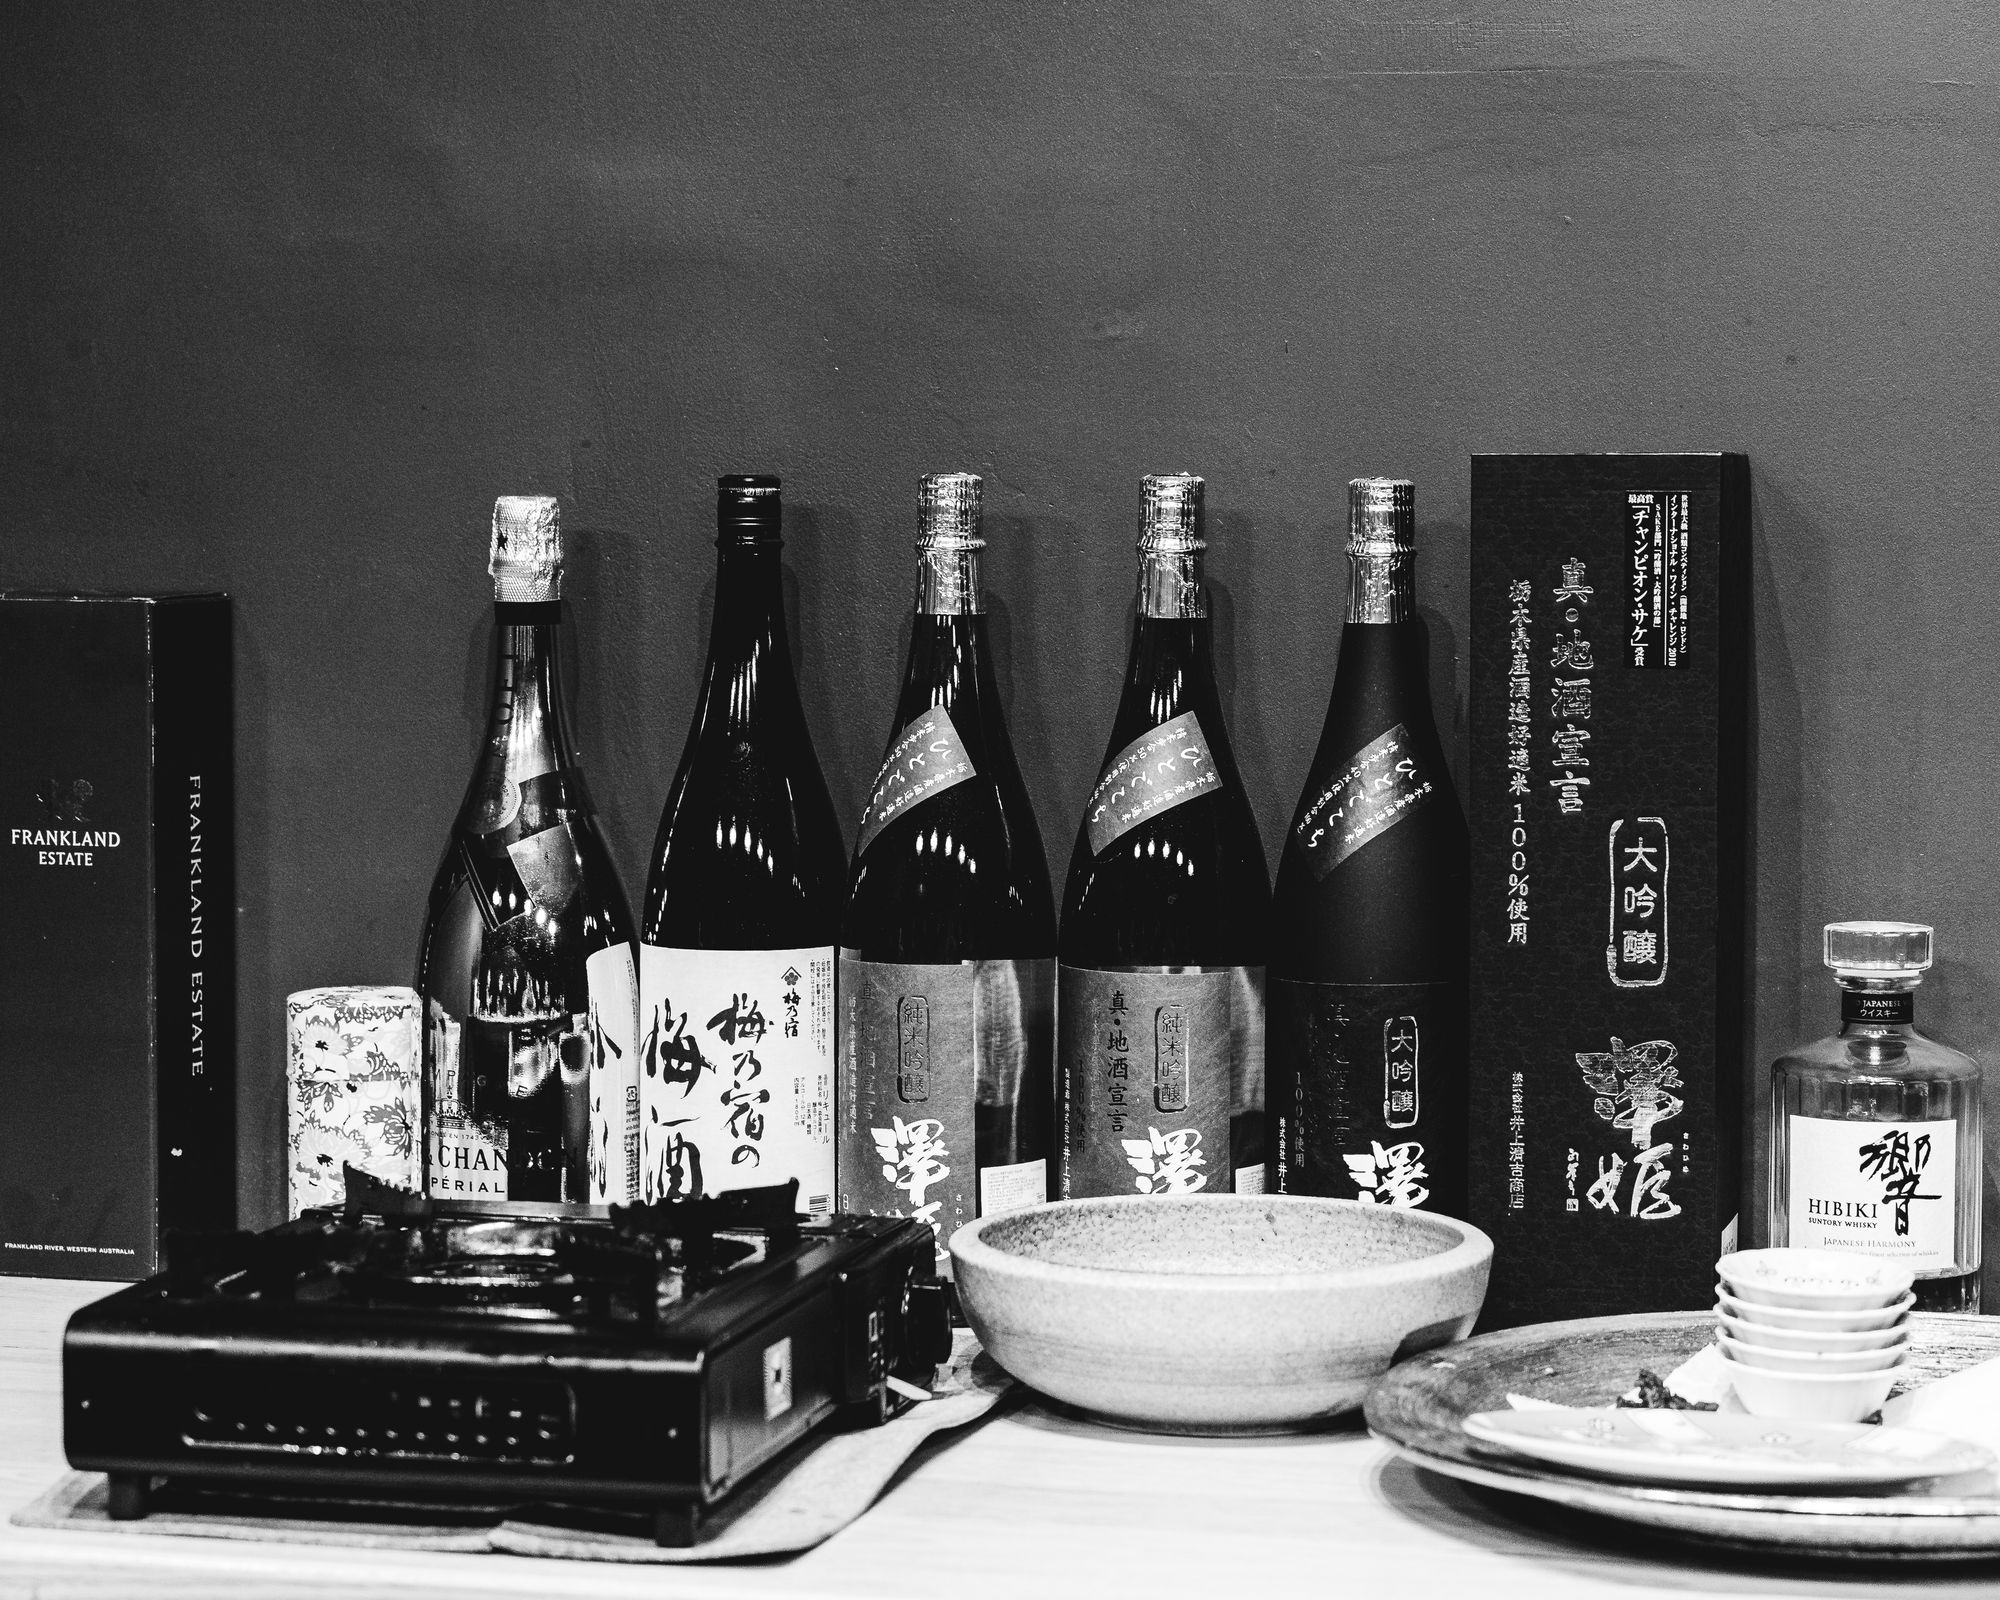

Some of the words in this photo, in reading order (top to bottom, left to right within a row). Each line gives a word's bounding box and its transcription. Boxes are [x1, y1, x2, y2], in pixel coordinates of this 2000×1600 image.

[1627, 493, 1655, 504] 最高賞
[1631, 504, 1651, 667] 「チャンピオン・サケ」受賞
[1668, 494, 1679, 646] インターナショナル・ワイン・チャレンジ
[1550, 557, 1595, 814] 真・地酒宣言
[1668, 647, 1677, 667] 2010
[11, 829, 121, 848] FRANKLAND
[38, 851, 94, 867] ESTATE
[189, 775, 203, 959] FRANKLAND
[1622, 836, 1659, 965] 大吟醸
[191, 971, 204, 1077] ESTATE
[782, 987, 802, 1039] 梅乃宿
[1860, 1008, 1899, 1018] ウイスキー
[1862, 999, 1902, 1008] JAPANESE
[706, 992, 775, 1169] 梅乃宿の
[903, 1002, 925, 1095] 純米吟醸
[1107, 989, 1129, 1133] 真・地酒宣言
[1161, 1012, 1184, 1105] 純米吟醸
[1391, 1029, 1414, 1113] 大吟醸
[822, 1089, 830, 1145] リキュール
[1808, 1198, 1878, 1219] HIBIKI
[1808, 1217, 1842, 1227] SUNTORY
[1844, 1220, 1878, 1229] WHISKY
[1859, 1130, 1943, 1237] 響
[4, 1242, 43, 1251] FRANKLAND
[98, 1247, 135, 1255] AUSTRALIA
